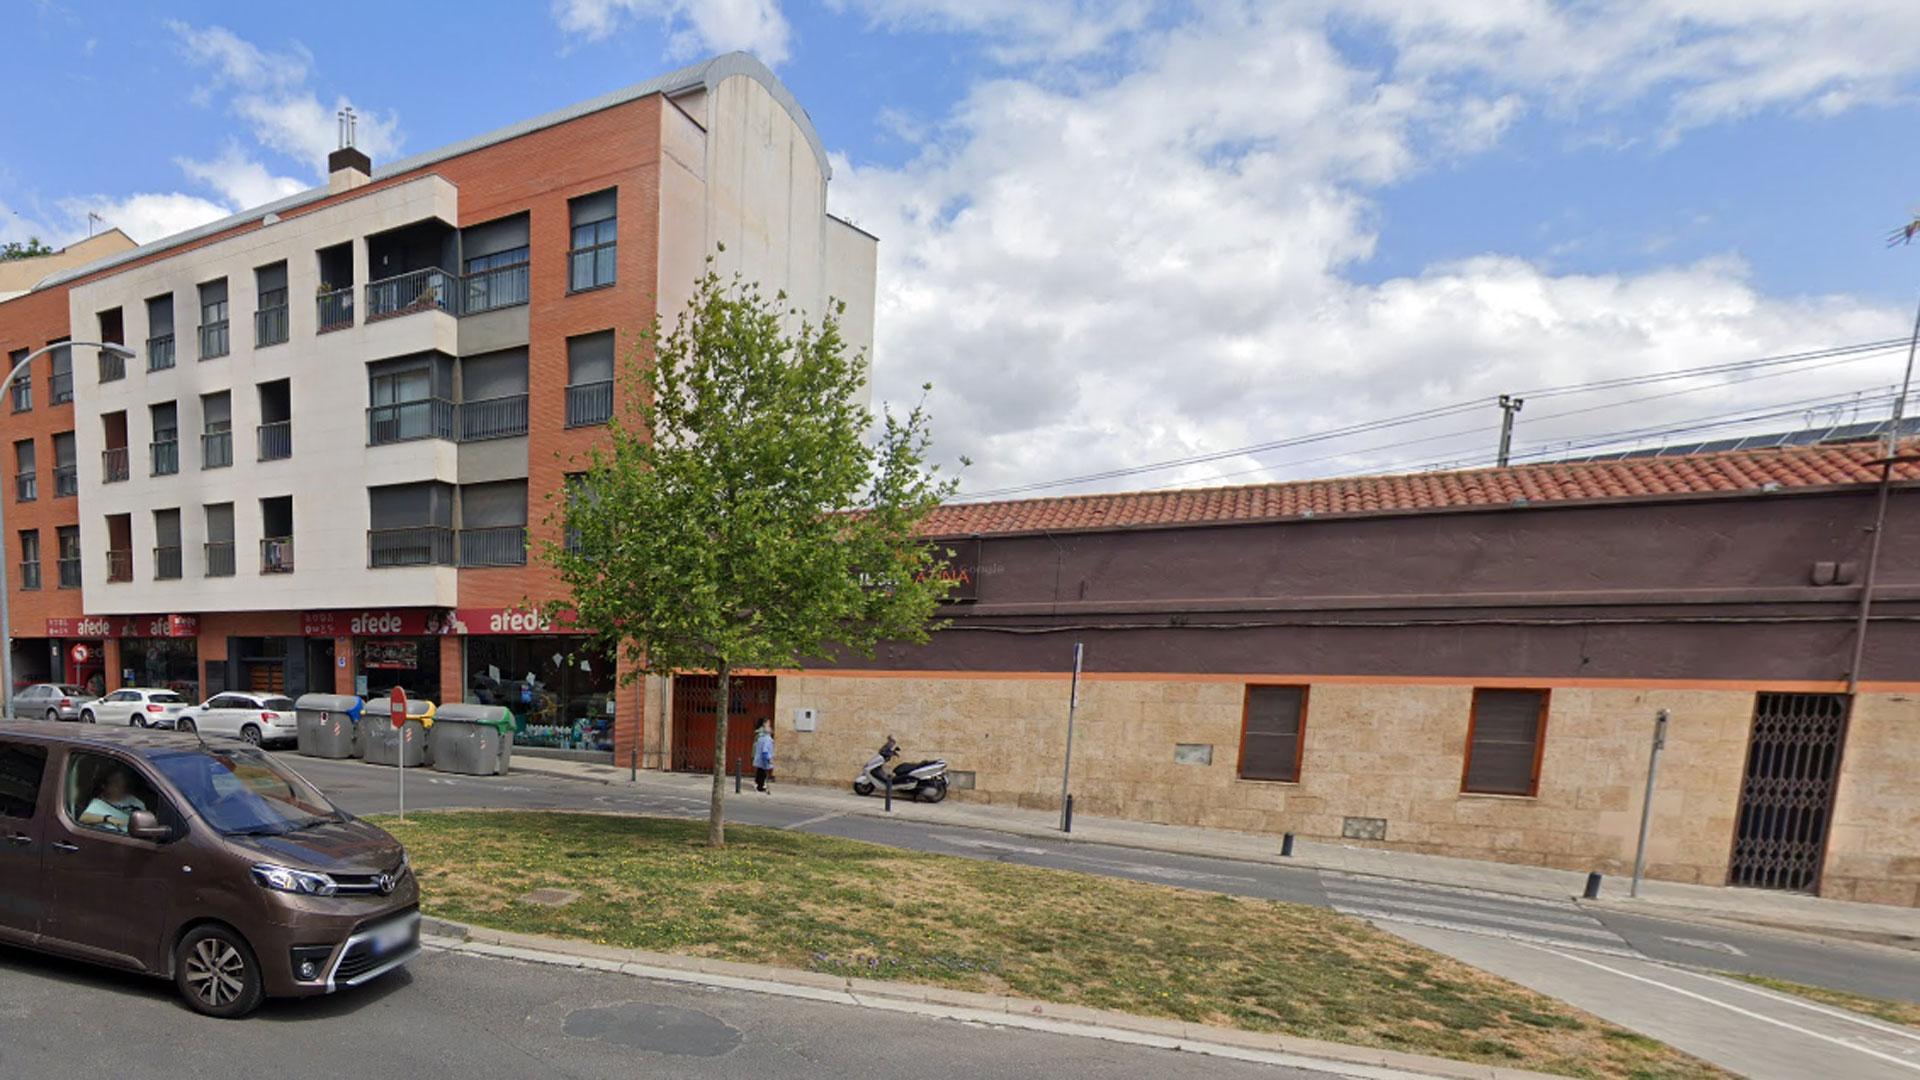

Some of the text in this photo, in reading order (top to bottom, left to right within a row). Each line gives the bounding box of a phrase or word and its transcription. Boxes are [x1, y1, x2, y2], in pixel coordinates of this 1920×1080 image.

[78, 618, 110, 636] afede
[150, 617, 170, 636] afe
[350, 612, 402, 634] afede
